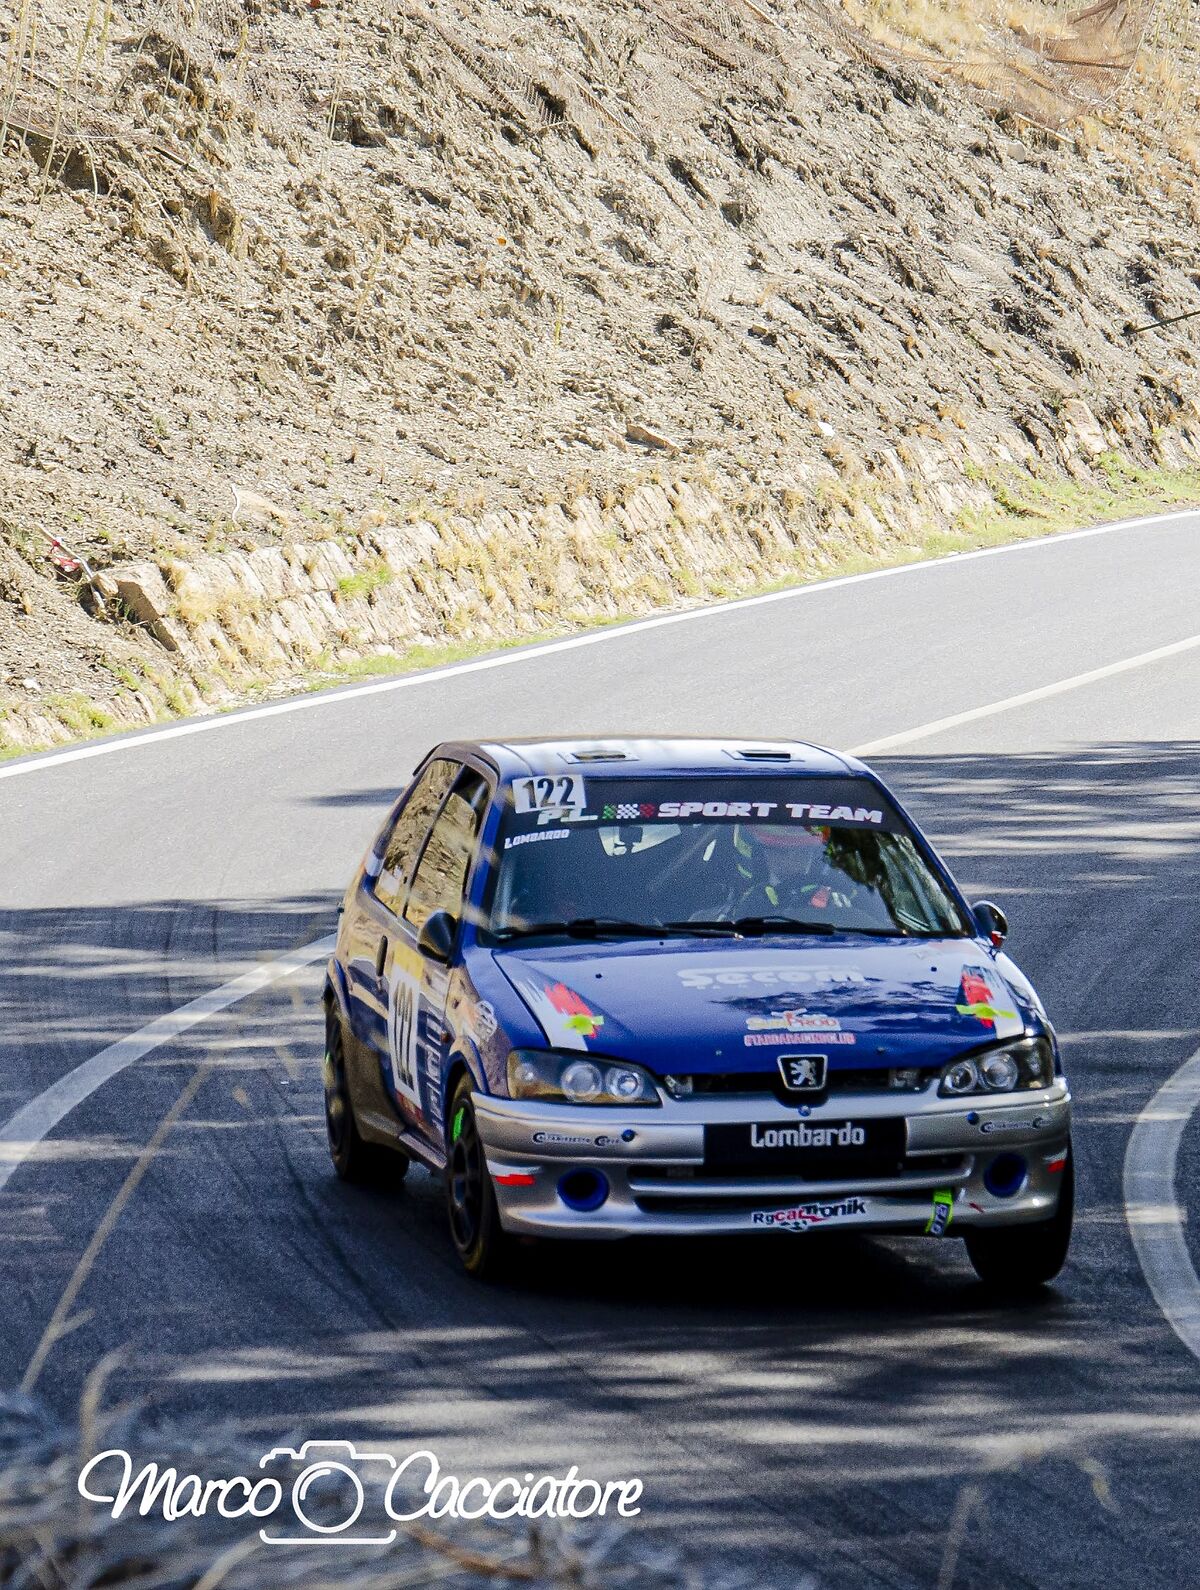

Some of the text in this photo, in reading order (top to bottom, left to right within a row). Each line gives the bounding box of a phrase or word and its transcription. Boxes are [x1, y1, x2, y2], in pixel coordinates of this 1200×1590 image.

[522, 776, 576, 810] 122
[658, 802, 882, 824] SPORT TEAM
[751, 1122, 865, 1148] Lombardo
